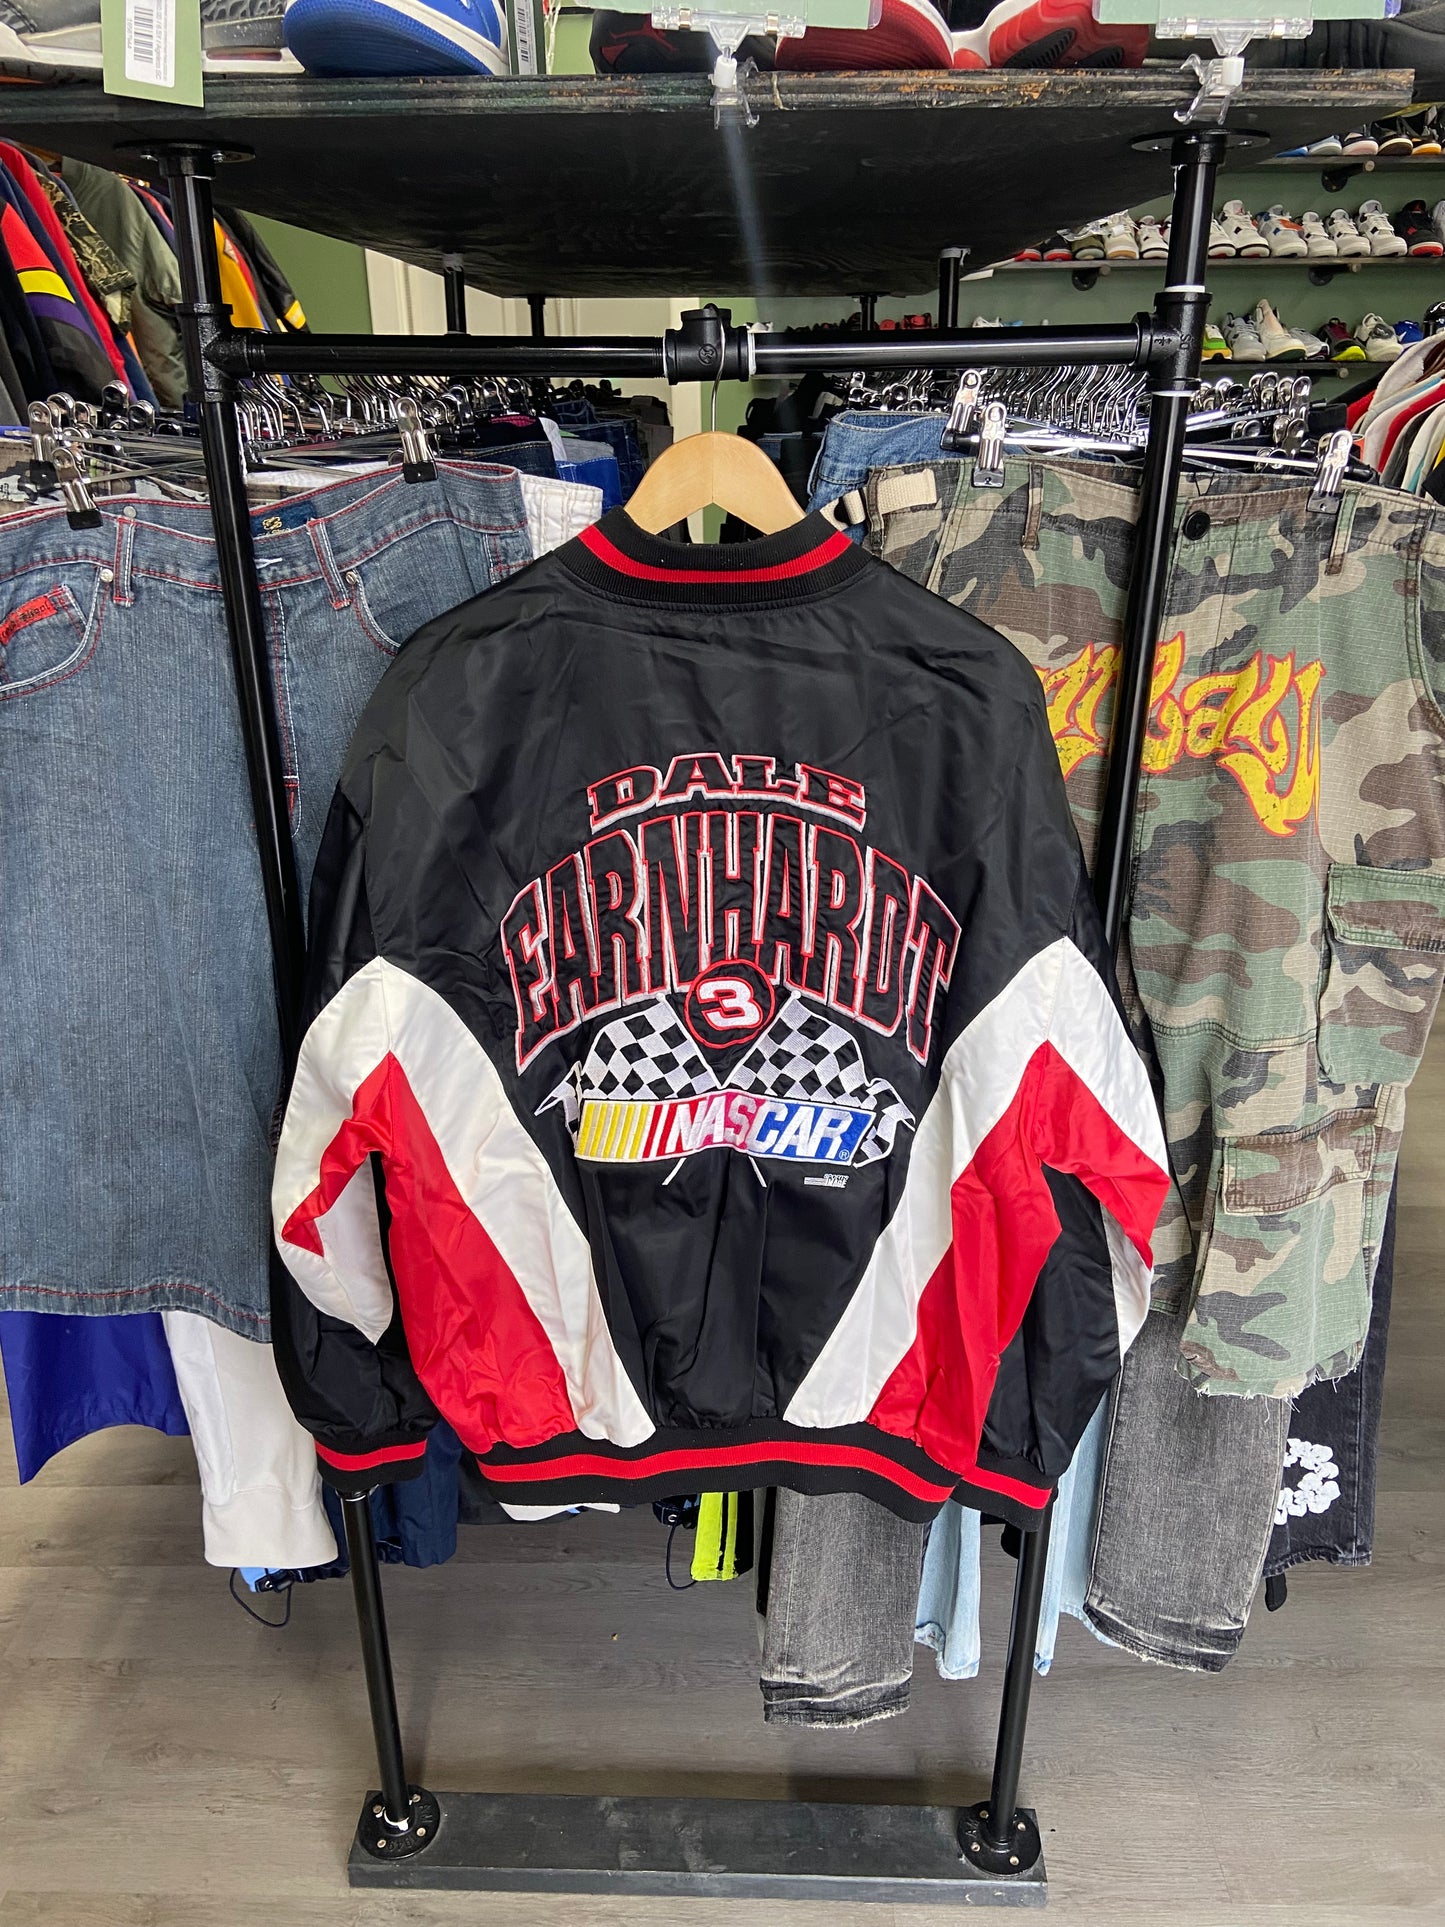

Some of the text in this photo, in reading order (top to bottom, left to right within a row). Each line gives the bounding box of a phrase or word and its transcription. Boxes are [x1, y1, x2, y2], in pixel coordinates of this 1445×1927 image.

[587, 752, 868, 833] DALE
[500, 811, 962, 1077] EARNHARDT
[694, 978, 764, 1029] 3
[664, 1094, 854, 1160] NASCAR
